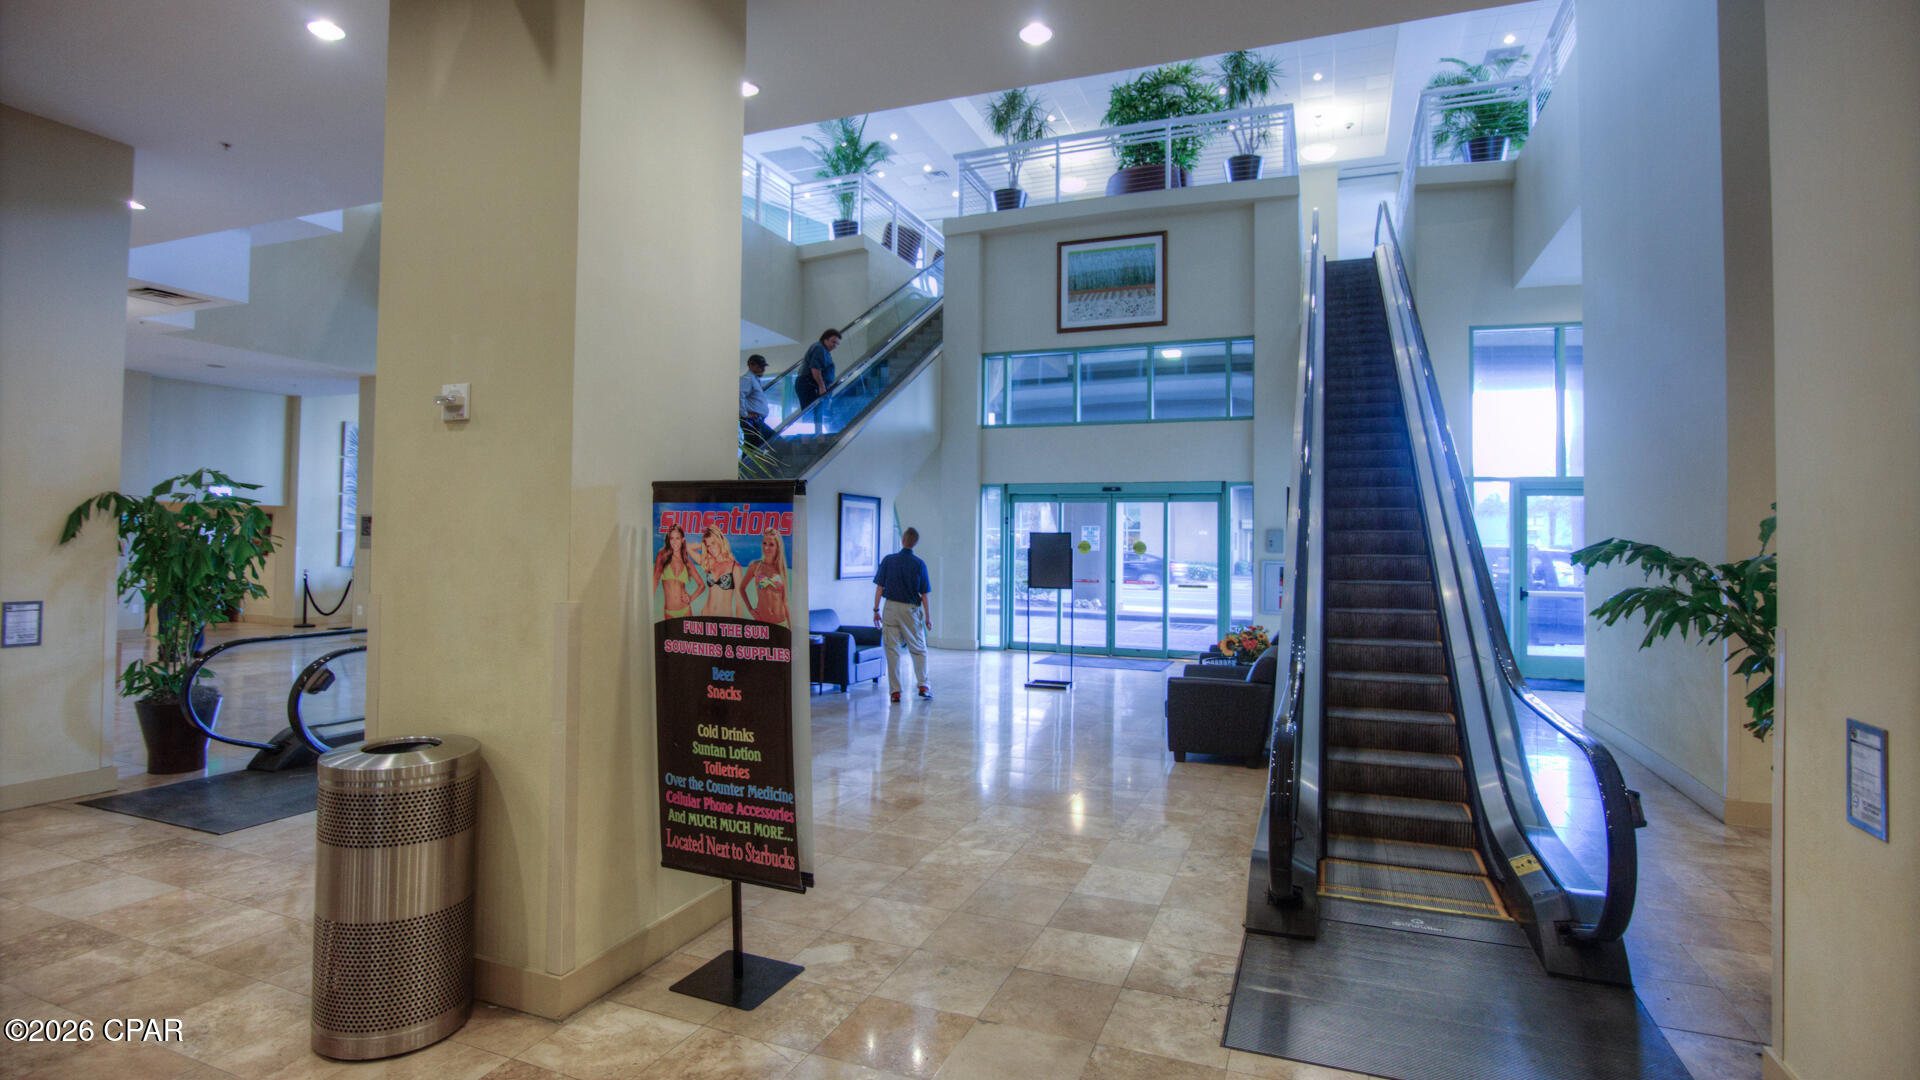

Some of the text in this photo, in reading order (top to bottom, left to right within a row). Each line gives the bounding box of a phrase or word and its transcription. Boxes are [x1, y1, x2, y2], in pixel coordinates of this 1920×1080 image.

[683, 620, 769, 639] FUN IN THE SUN
[664, 639, 791, 662] SOUVENIRS & SUPPLIES
[712, 666, 736, 682] Beer
[707, 684, 742, 701] Snacks
[697, 723, 754, 743] Cold Drinks
[692, 741, 762, 762] Suntan Lotion
[665, 772, 793, 804] Over the Counter Medicine
[666, 791, 795, 823] Cellular Phone Accessories
[668, 808, 686, 824] And
[688, 812, 717, 829] MUCH
[720, 818, 751, 835] MUCH
[666, 828, 704, 854] Located
[731, 841, 743, 860] to
[745, 842, 795, 870] Starbucks
